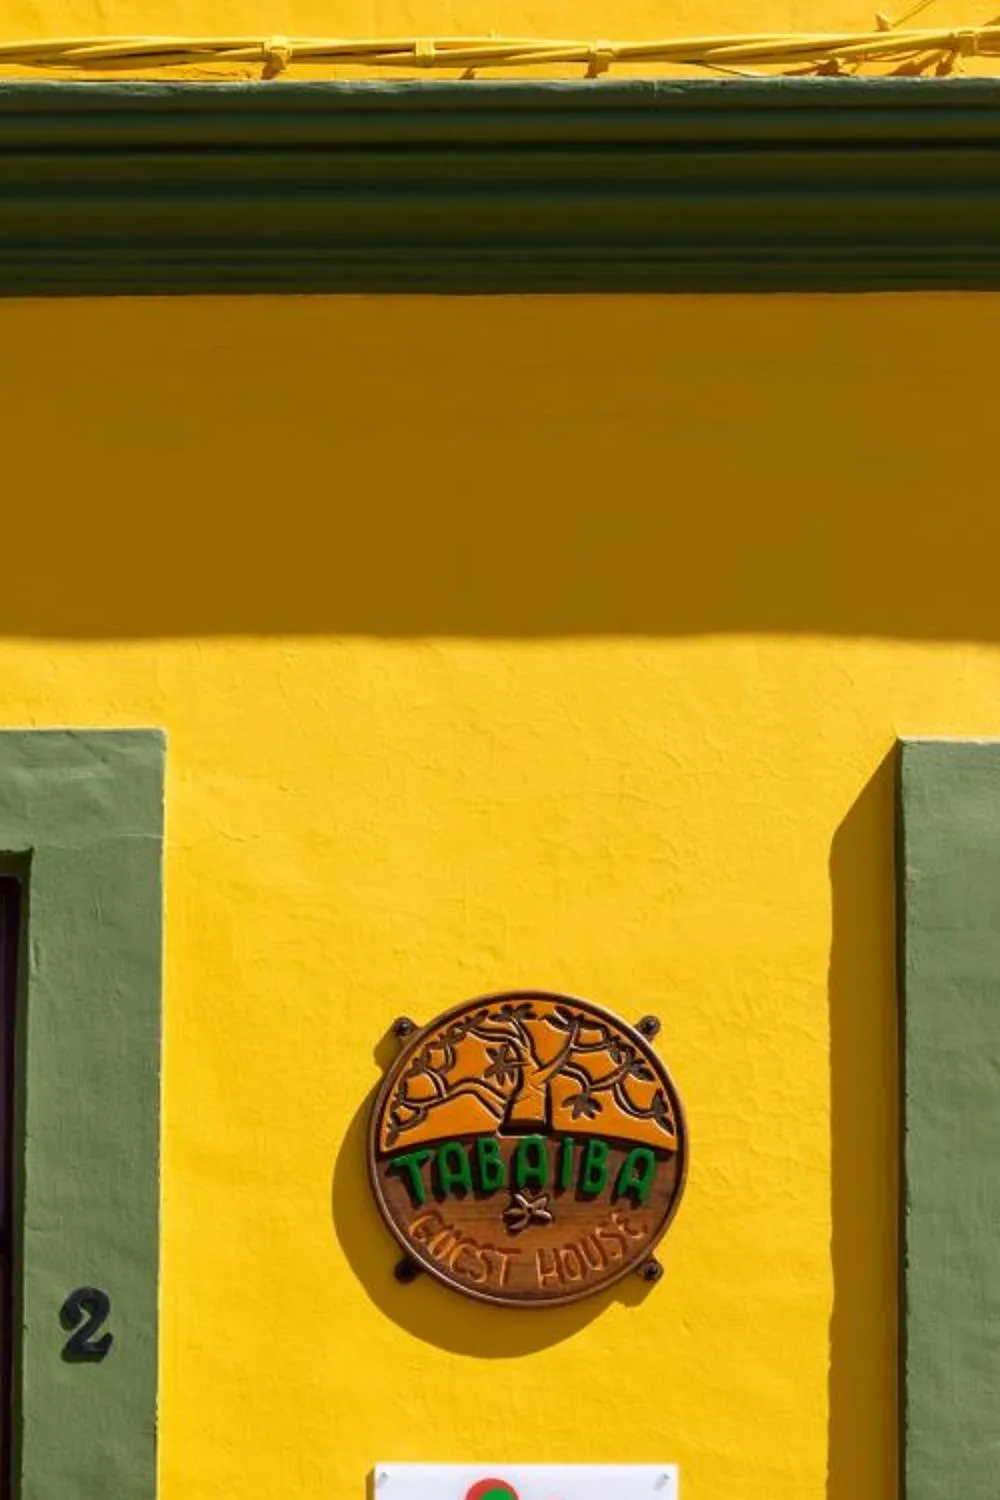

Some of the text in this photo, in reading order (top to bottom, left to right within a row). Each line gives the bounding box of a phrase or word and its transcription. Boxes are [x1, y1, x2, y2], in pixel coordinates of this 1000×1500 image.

[388, 1134, 657, 1205] TABAIBA
[408, 1209, 649, 1288] GUEST HOUSE
[59, 1287, 114, 1364] 2
